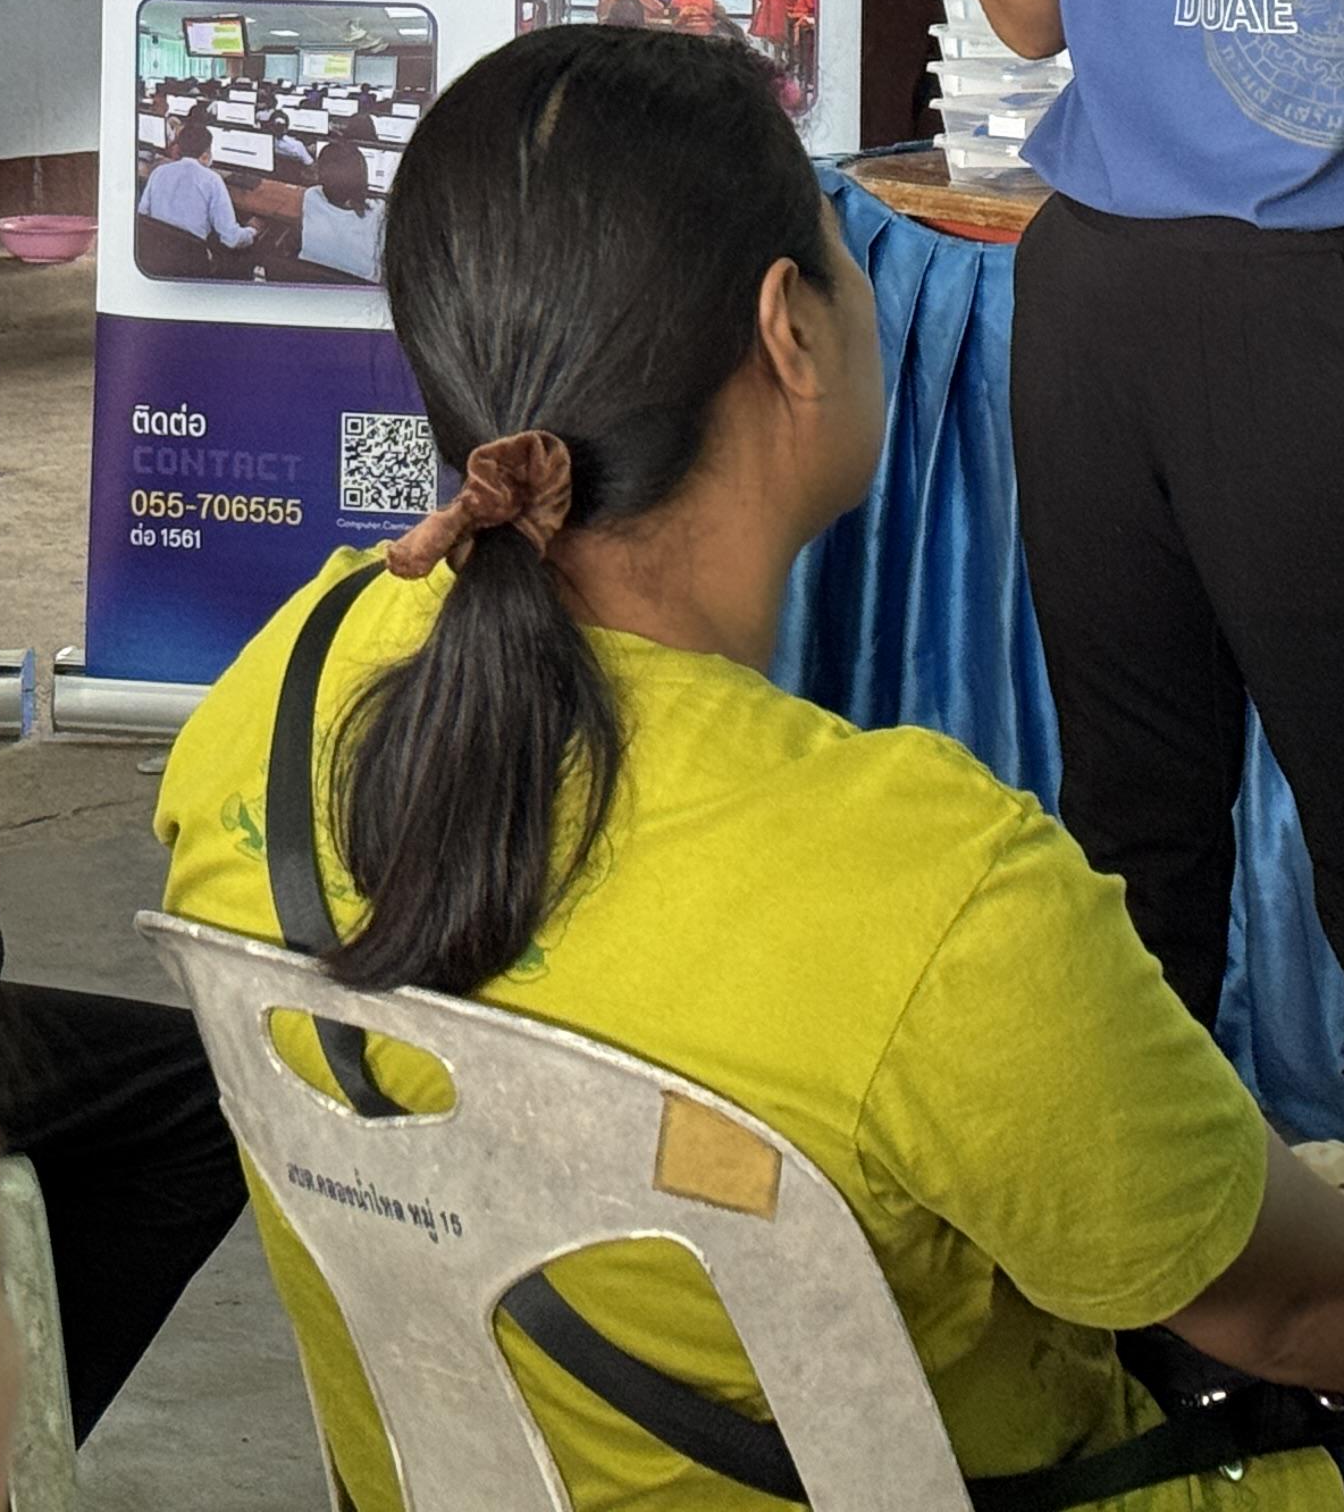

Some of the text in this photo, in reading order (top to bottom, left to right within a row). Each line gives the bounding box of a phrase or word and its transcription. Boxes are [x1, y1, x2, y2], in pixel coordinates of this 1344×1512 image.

[132, 403, 206, 437] ติดต่อ
[132, 445, 304, 482] CONTACT
[131, 489, 303, 526] 055-706555
[130, 526, 202, 549] ต่อ 1561
